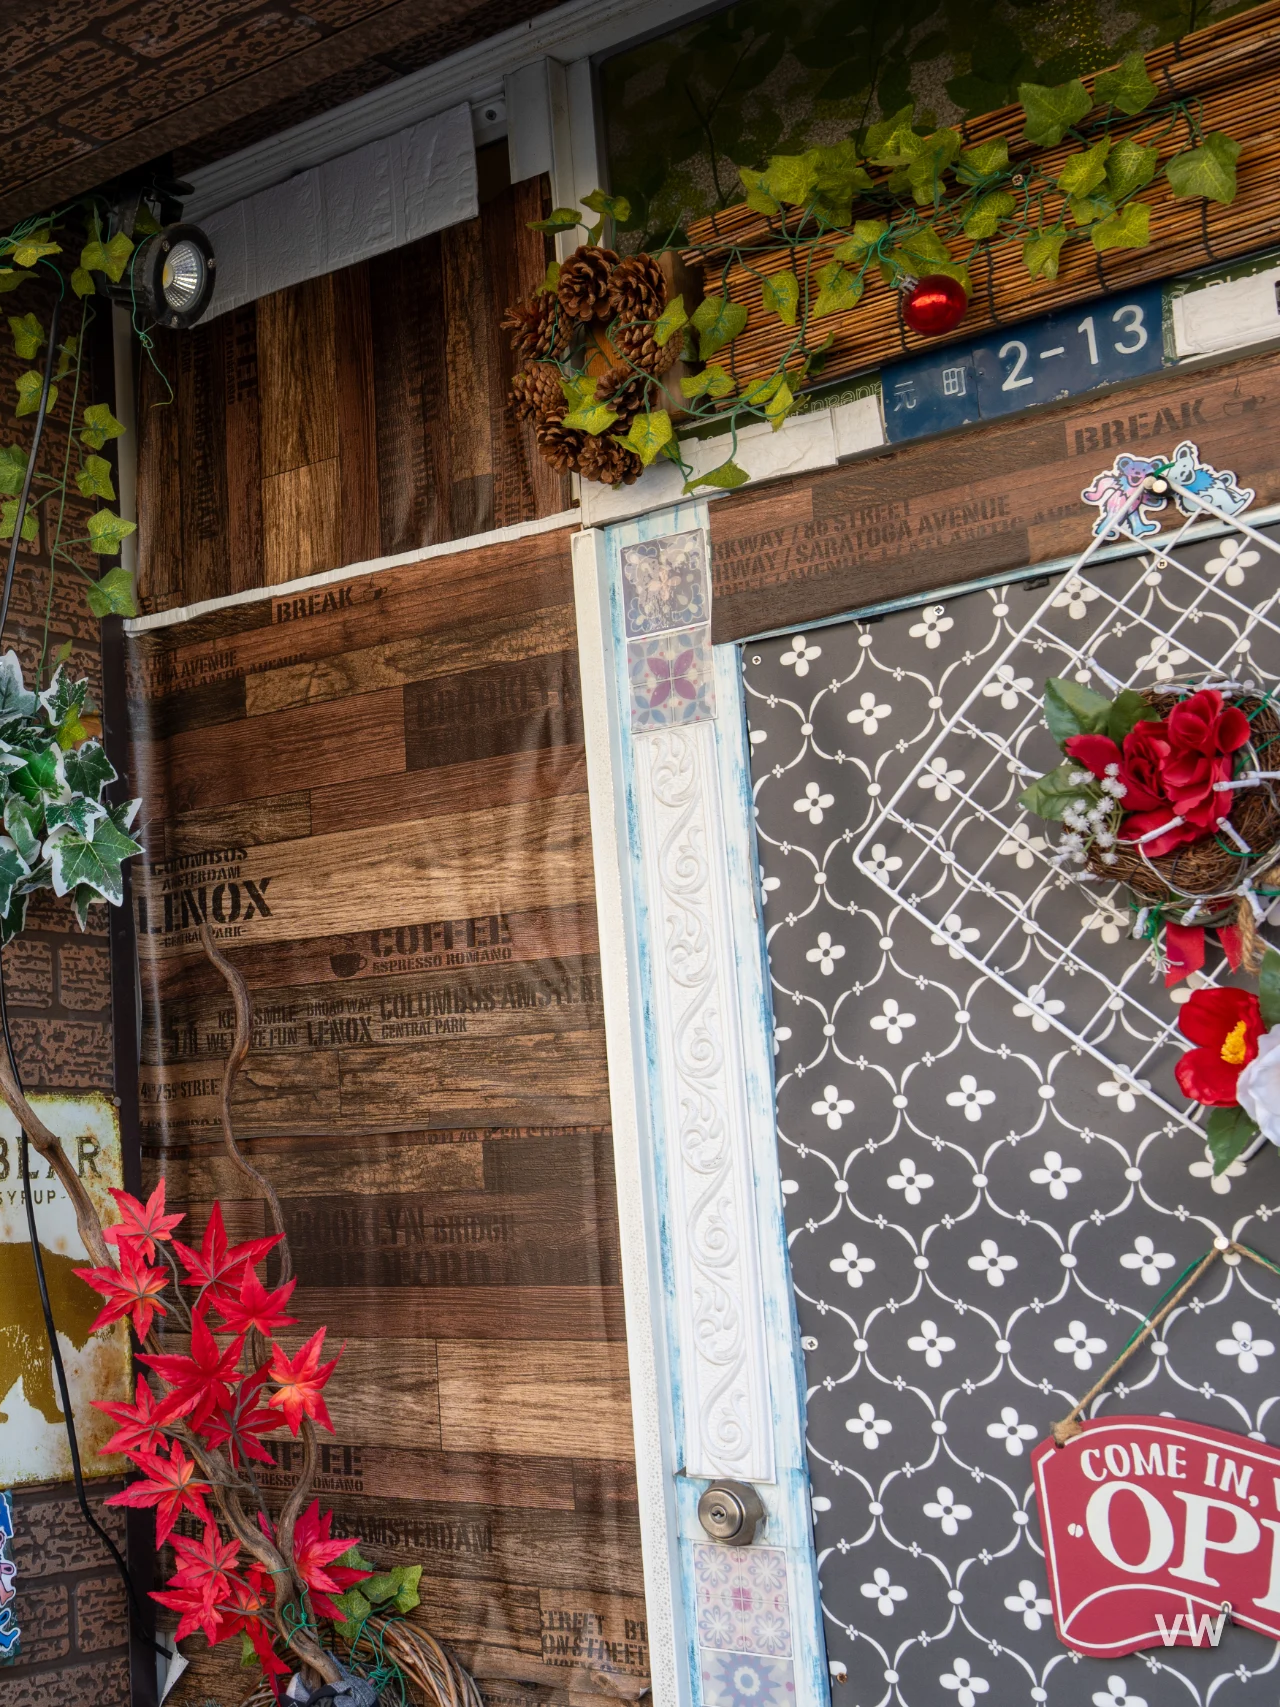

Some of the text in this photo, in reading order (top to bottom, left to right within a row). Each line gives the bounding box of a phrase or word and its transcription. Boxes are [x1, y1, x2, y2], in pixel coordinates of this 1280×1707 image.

[894, 367, 966, 411] 元町
[999, 304, 1148, 391] 2-13
[1075, 397, 1211, 455] BREAK
[919, 494, 1010, 535] AVENUE
[276, 586, 353, 623] BREAK
[138, 877, 273, 934] LENOX
[372, 955, 443, 975] ESPRESSO
[305, 1015, 373, 1047] LENOX
[382, 1017, 467, 1040] CENTRAL PARK
[1080, 1443, 1187, 1482] COME
[1203, 1453, 1259, 1507] IN,
